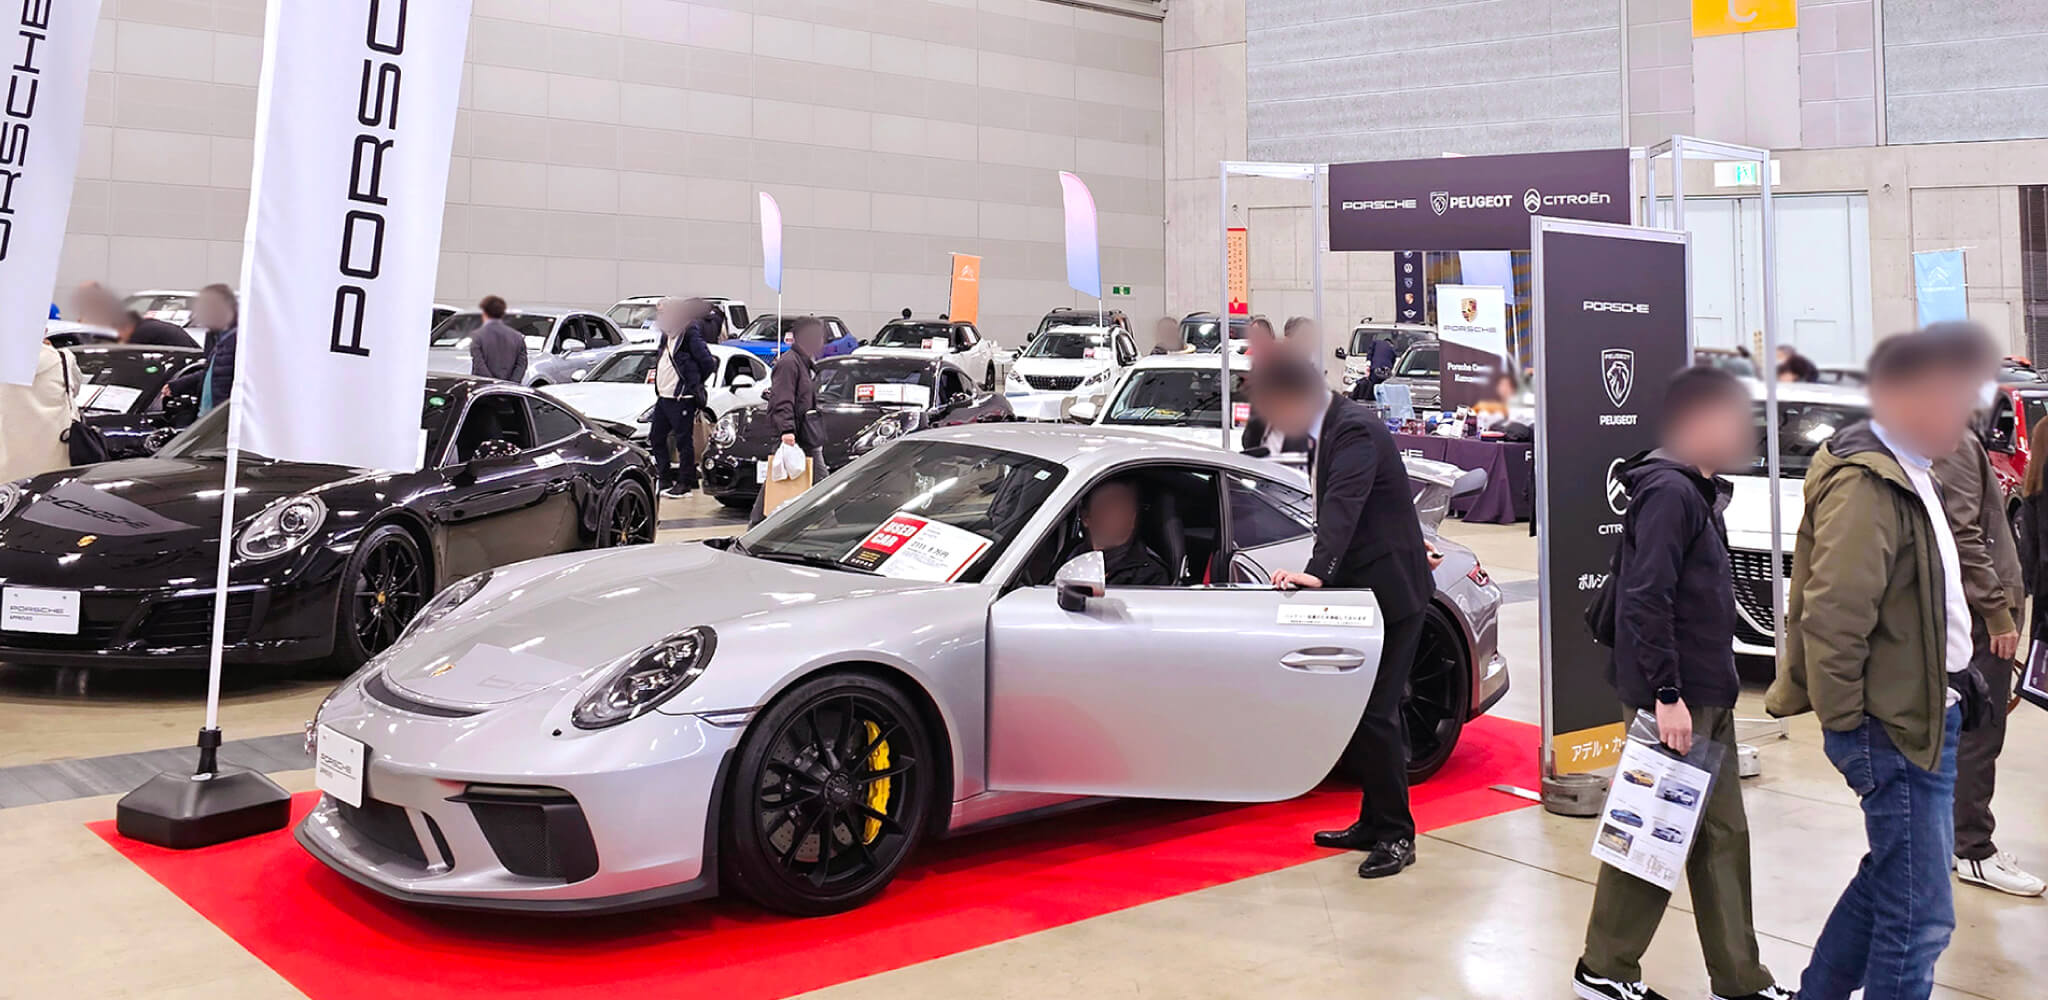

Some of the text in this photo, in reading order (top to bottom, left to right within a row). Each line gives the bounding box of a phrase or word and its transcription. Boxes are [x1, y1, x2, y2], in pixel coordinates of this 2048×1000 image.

[1342, 192, 1610, 211] PORSCHE PEUGEOT CITROËN
[1583, 300, 1649, 313] PORSCHE
[1443, 325, 1496, 333] PORSCHE
[1600, 415, 1637, 425] PEUGEOT
[884, 522, 917, 537] USED
[871, 533, 898, 547] CAR
[10, 605, 64, 614] PORSCHE
